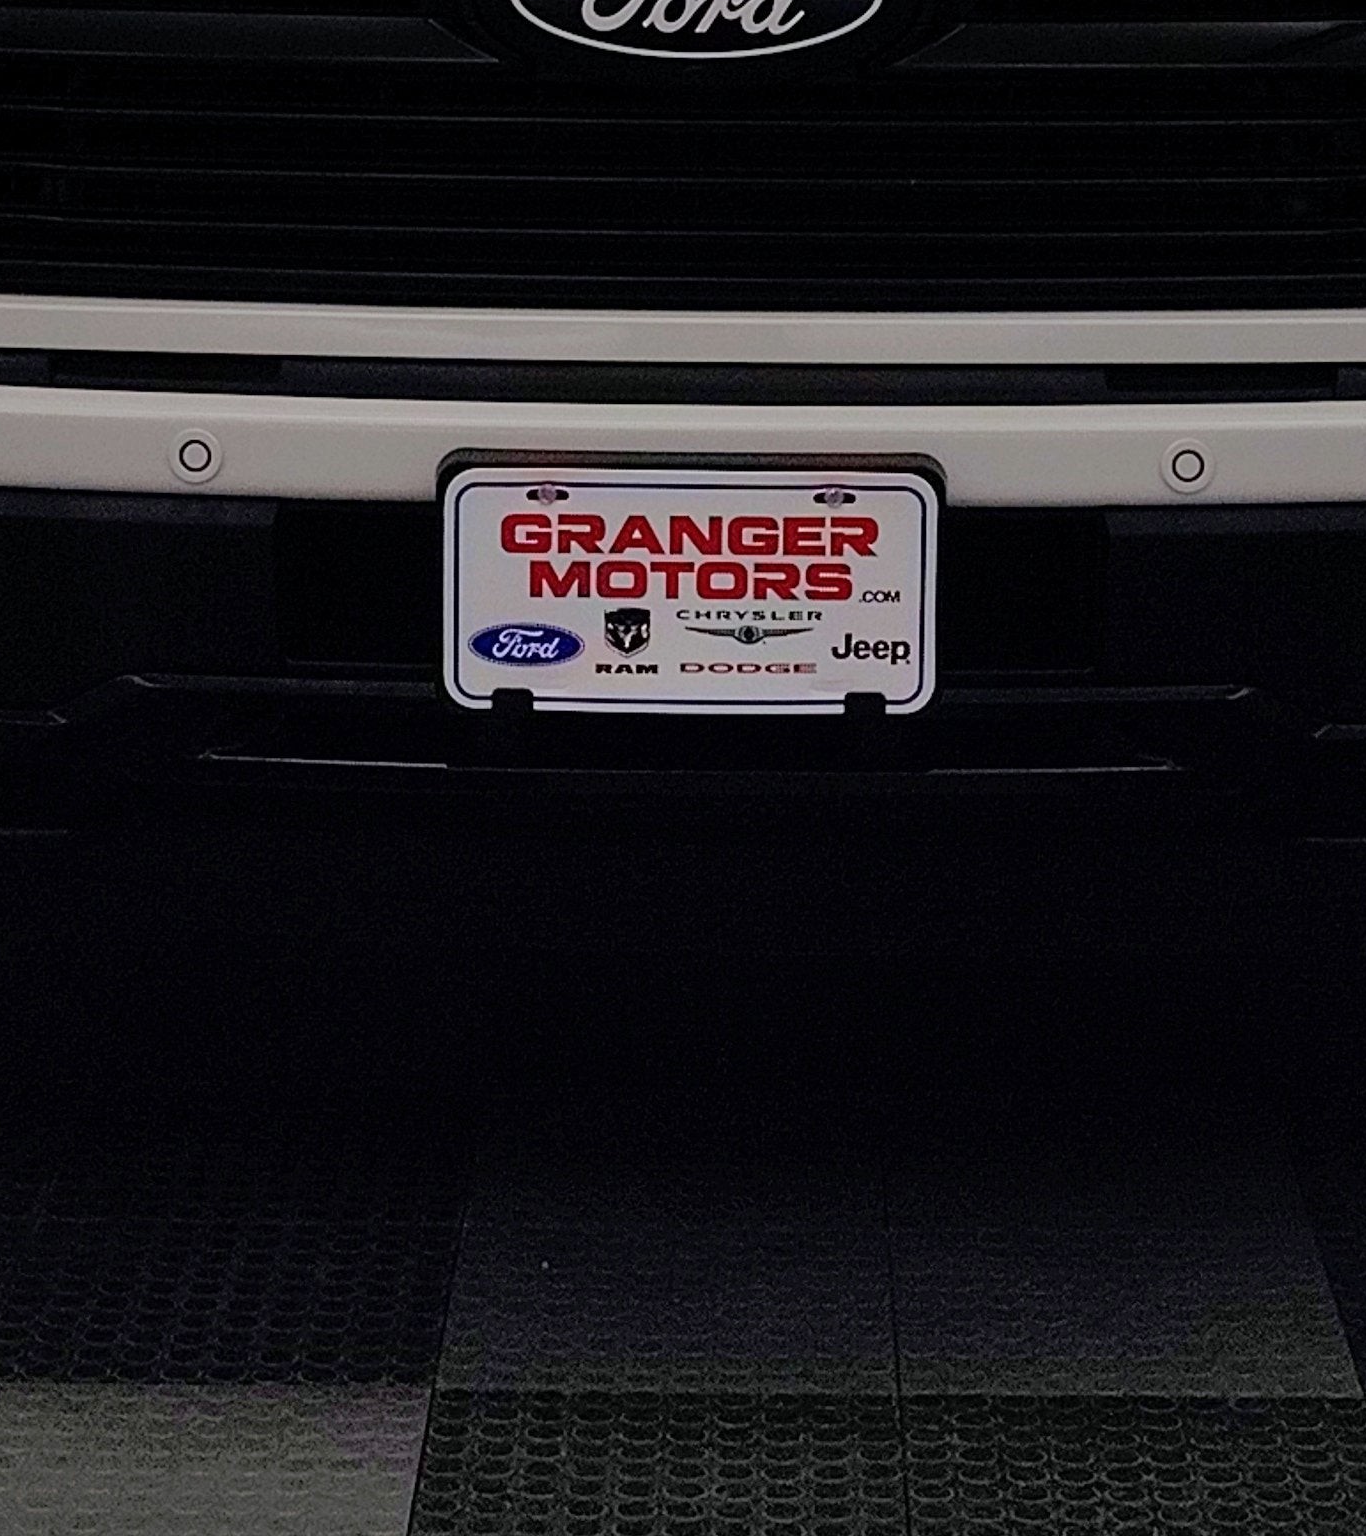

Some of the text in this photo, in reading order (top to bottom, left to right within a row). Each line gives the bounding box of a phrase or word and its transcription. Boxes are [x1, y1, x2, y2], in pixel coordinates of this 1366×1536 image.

[500, 513, 880, 556] GRANGER
[529, 560, 901, 603] MOTORS .COM
[676, 609, 823, 621] CHRYSLER
[492, 628, 560, 659] Ford
[831, 633, 911, 665] Jeep
[595, 663, 658, 674] RAM
[680, 662, 817, 674] DODGE
